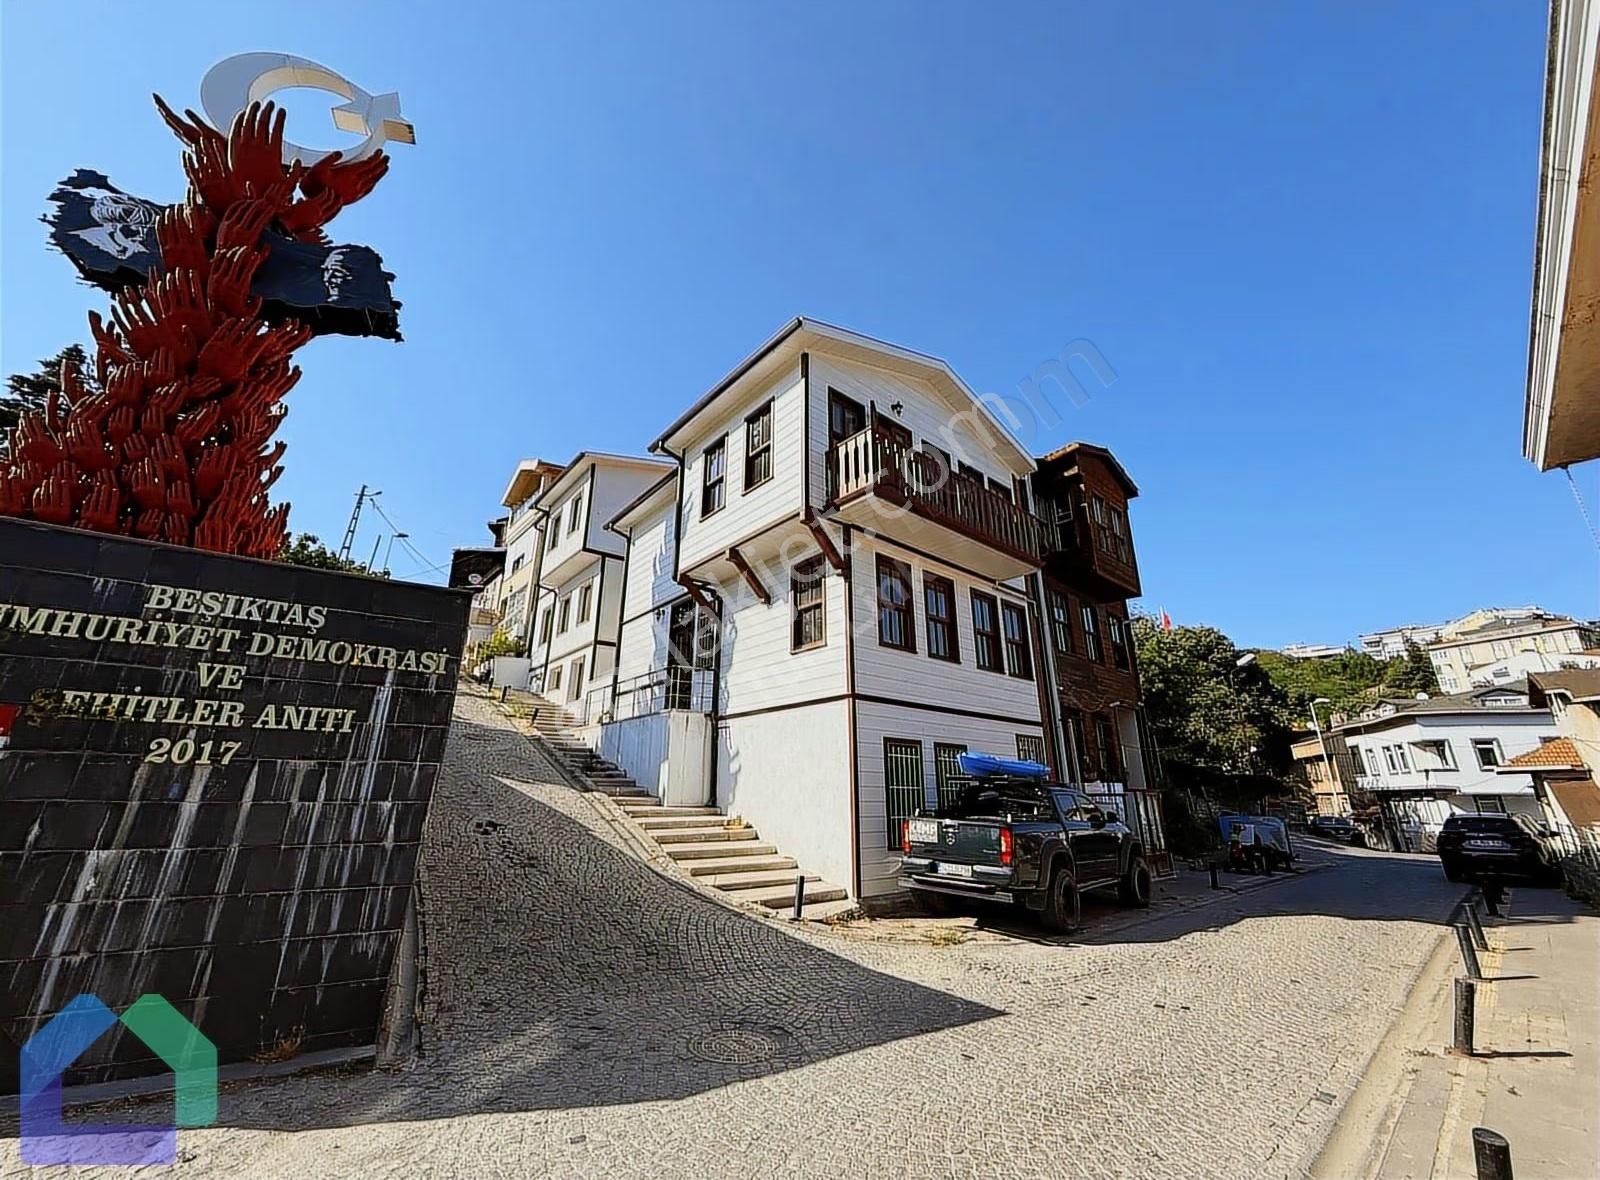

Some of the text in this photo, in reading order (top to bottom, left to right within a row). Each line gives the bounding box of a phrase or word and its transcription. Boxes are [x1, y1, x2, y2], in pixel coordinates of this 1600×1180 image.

[245, 632, 449, 675] DEMOKRASİ
[197, 662, 248, 691] VE
[251, 704, 357, 734] ANITI
[144, 737, 243, 766] 2017
